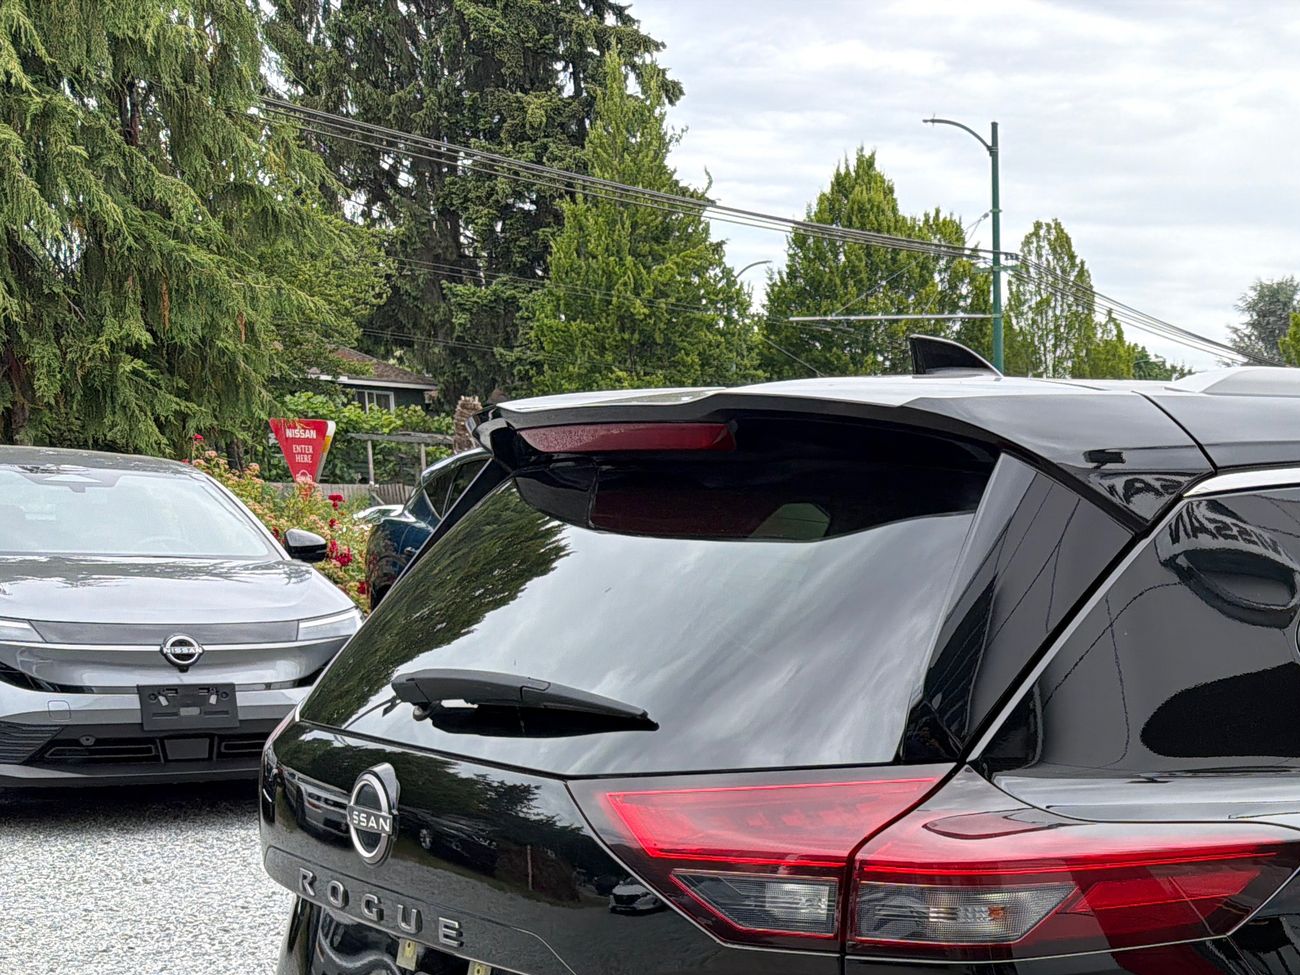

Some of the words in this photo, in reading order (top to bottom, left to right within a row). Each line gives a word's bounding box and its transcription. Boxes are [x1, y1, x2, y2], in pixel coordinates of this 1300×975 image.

[286, 428, 317, 439] NISSAN
[292, 444, 313, 454] ENTER
[295, 454, 313, 463] HERE
[300, 867, 464, 948] ROGUE
